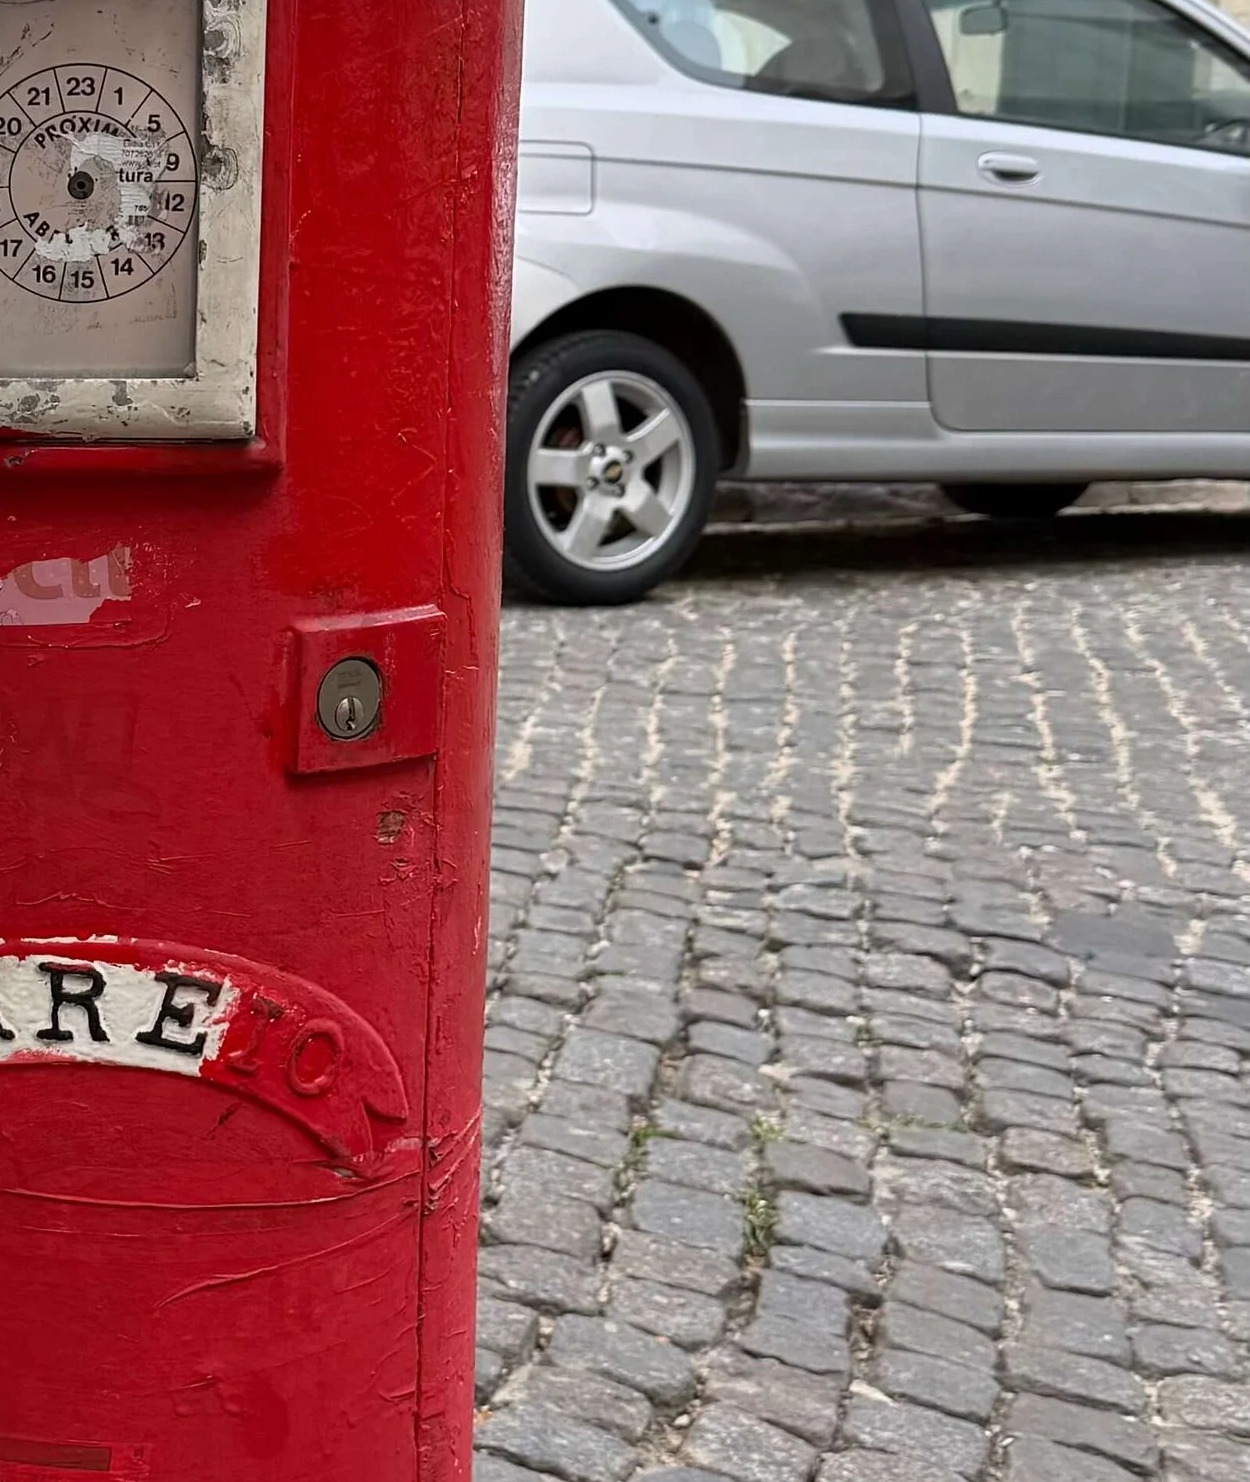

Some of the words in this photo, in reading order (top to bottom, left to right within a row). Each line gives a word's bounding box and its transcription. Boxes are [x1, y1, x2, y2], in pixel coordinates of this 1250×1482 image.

[66, 77, 95, 96] 23
[114, 86, 124, 106] 1
[27, 87, 51, 106] 21
[147, 114, 161, 133] 5
[166, 152, 180, 172] 9
[0, 239, 23, 258] 17
[32, 264, 56, 284] 16
[111, 258, 135, 277] 14
[70, 270, 95, 289] 15
